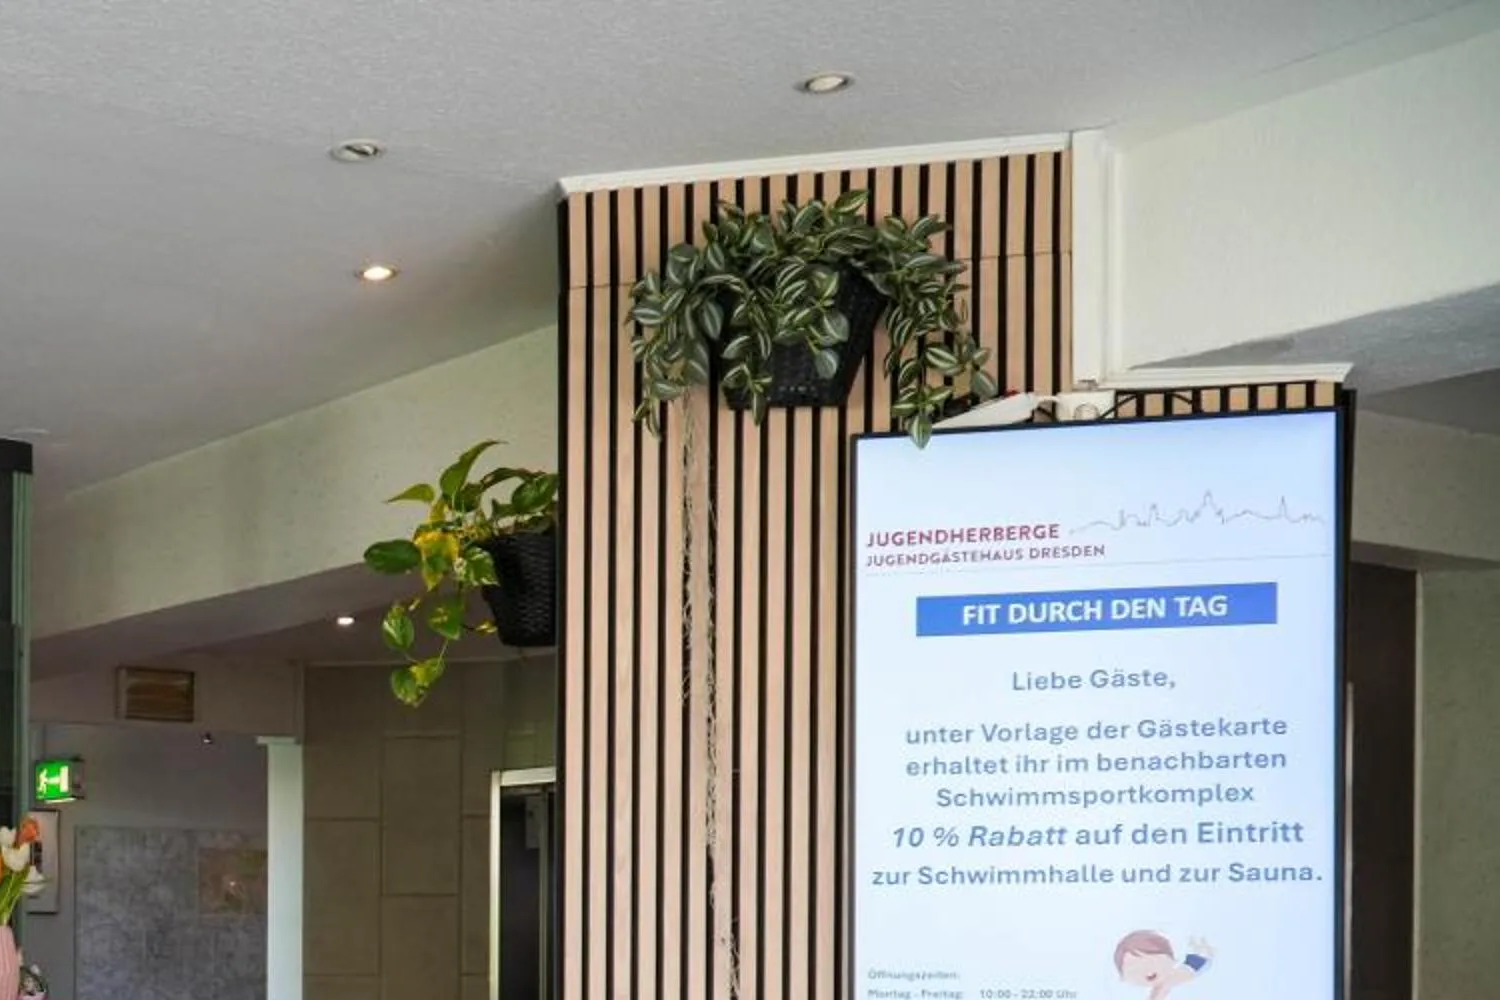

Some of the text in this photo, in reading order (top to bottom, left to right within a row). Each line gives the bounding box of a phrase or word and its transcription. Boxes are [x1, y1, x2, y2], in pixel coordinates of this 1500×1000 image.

[866, 524, 1060, 547] JUGENDHERBERGE
[866, 545, 1106, 567] JUGENDGÄSTEHAUS DRESDEN
[963, 595, 1228, 625] FIT DURCH DEN TAG
[1013, 669, 1176, 691] Liebe Gäste,
[906, 717, 1288, 746] unter Vorlage der Gästekarte
[906, 750, 1287, 776] erhaltet ihr im benachbarten
[937, 783, 1253, 808] Schwimmsportkomplex
[893, 821, 1304, 848] 10 % Rabatt auf den Eintritt
[872, 862, 1323, 885] zur Schwimmhalle und zur Sauna.
[868, 989, 911, 1000] Montag
[979, 989, 1011, 999] 10:00
[1056, 989, 1077, 999] Uhr
